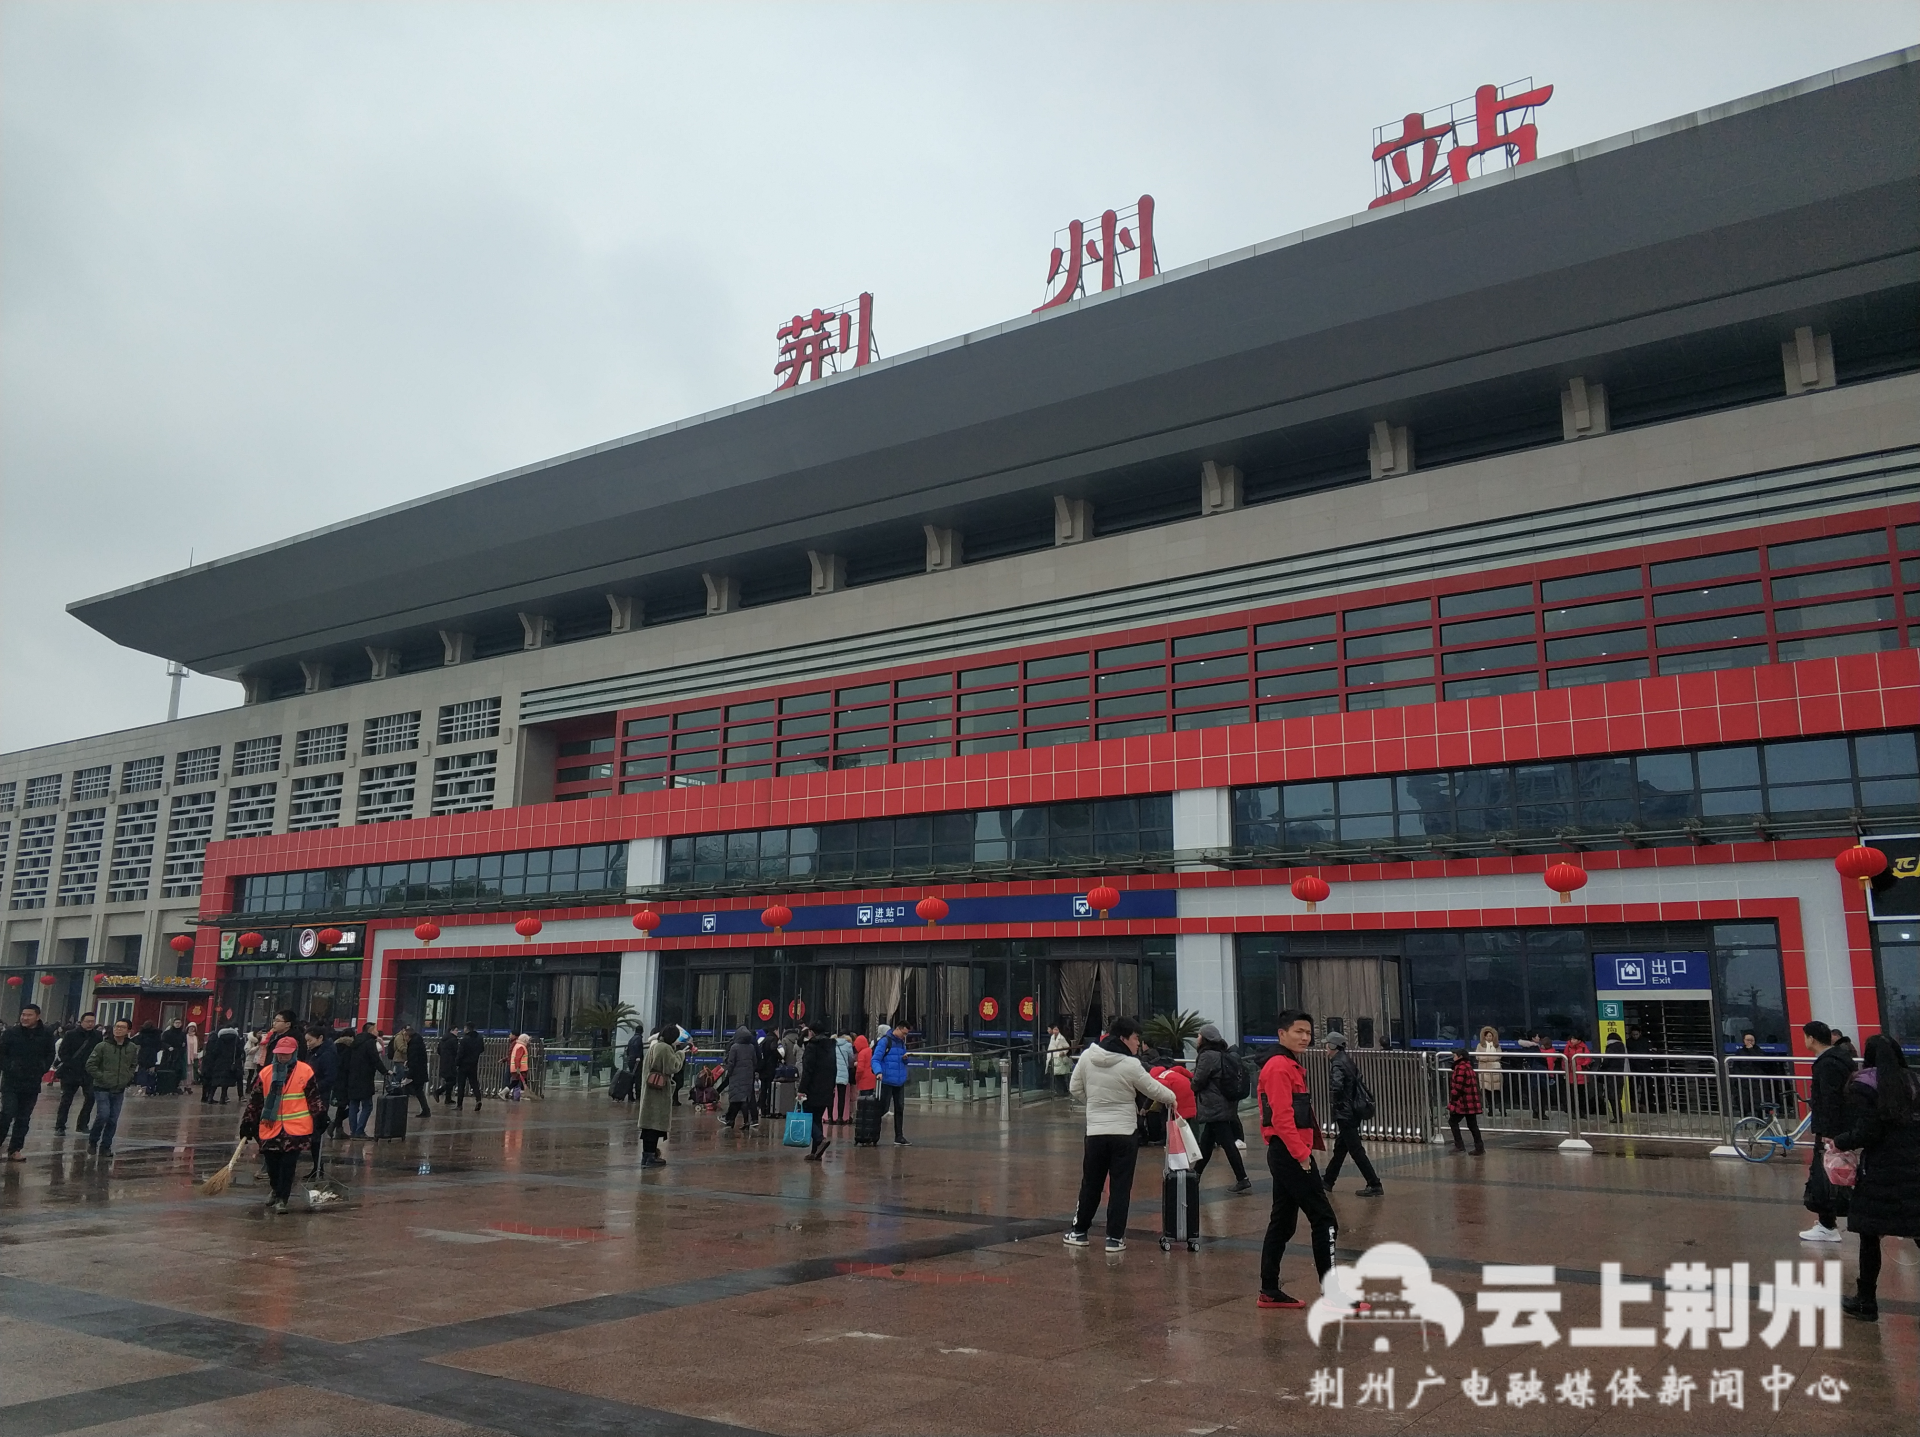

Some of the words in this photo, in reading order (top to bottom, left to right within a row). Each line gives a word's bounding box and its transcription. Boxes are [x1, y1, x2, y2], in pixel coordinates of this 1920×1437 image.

[774, 84, 1553, 391] 荆州站
[875, 906, 905, 918] 进站口
[1651, 959, 1687, 976] 出口
[1652, 976, 1671, 985] Exit
[983, 1002, 994, 1015] 福
